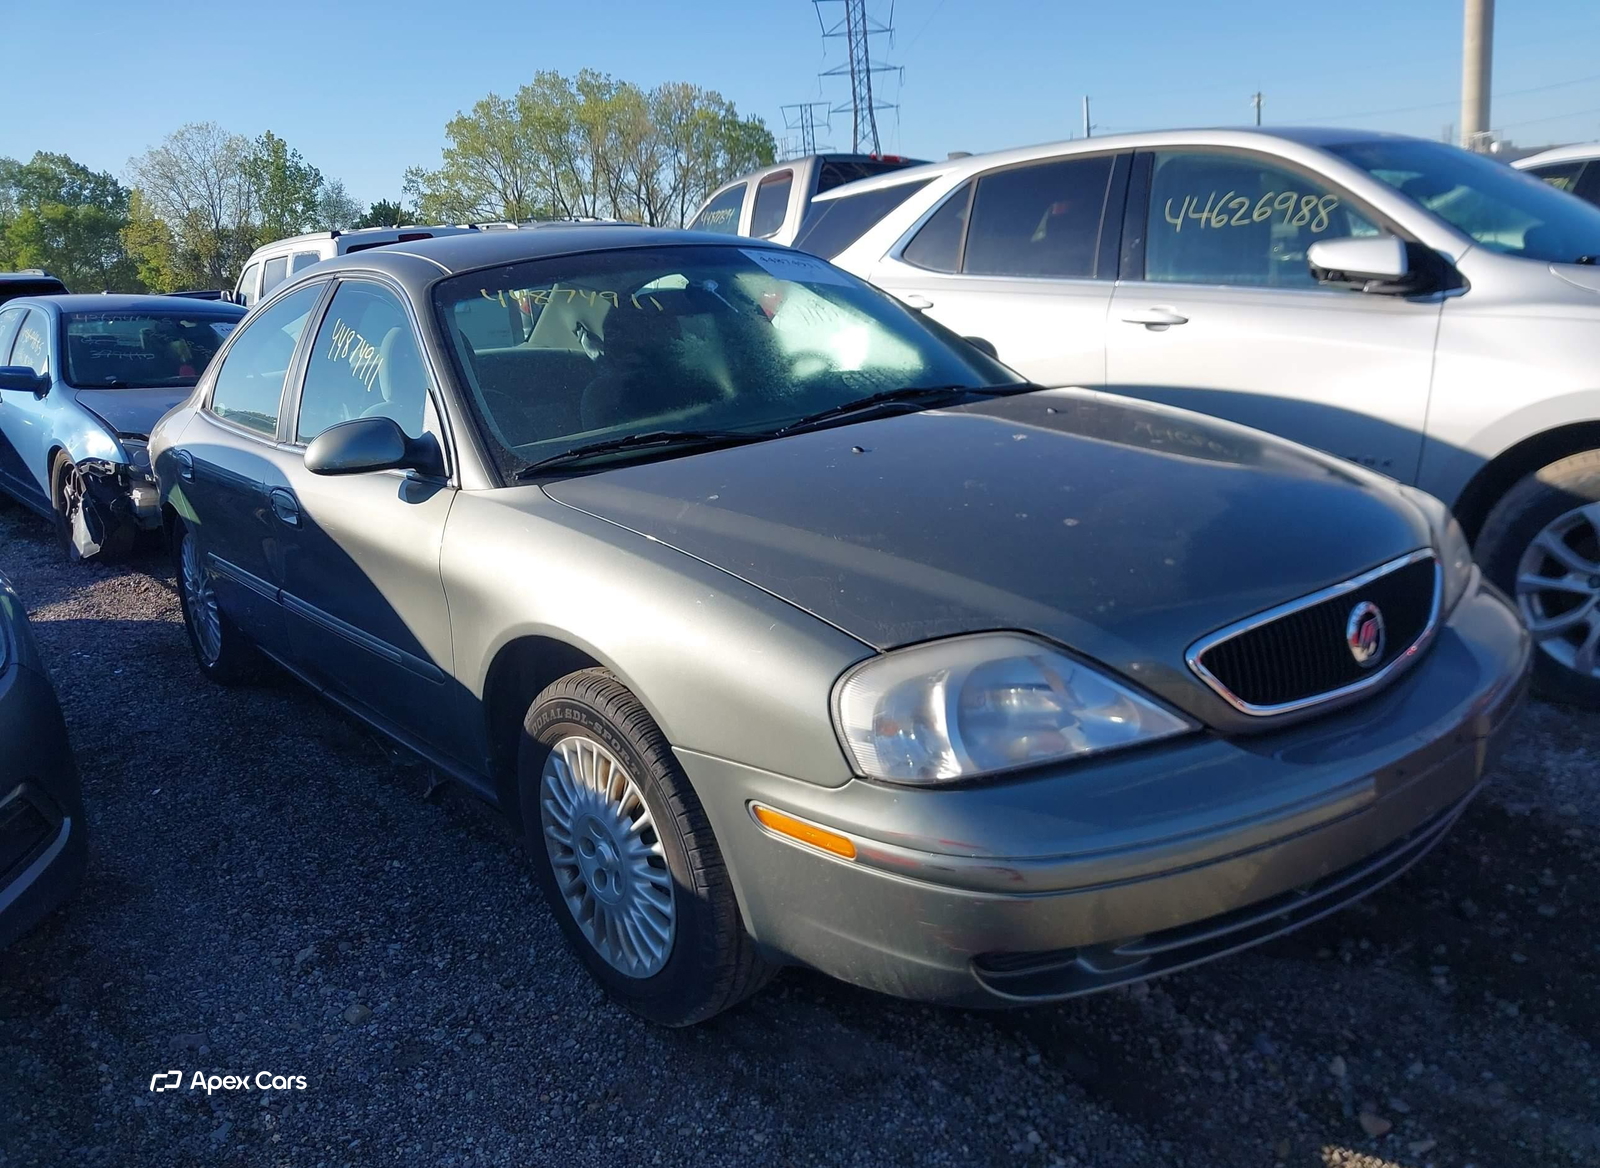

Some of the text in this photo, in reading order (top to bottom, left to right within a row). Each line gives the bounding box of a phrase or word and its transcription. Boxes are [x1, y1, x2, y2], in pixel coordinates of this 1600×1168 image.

[1165, 190, 1340, 233] 44626988
[479, 288, 664, 312] 44874911
[327, 318, 384, 392] 44874911
[531, 707, 564, 736] DORAL
